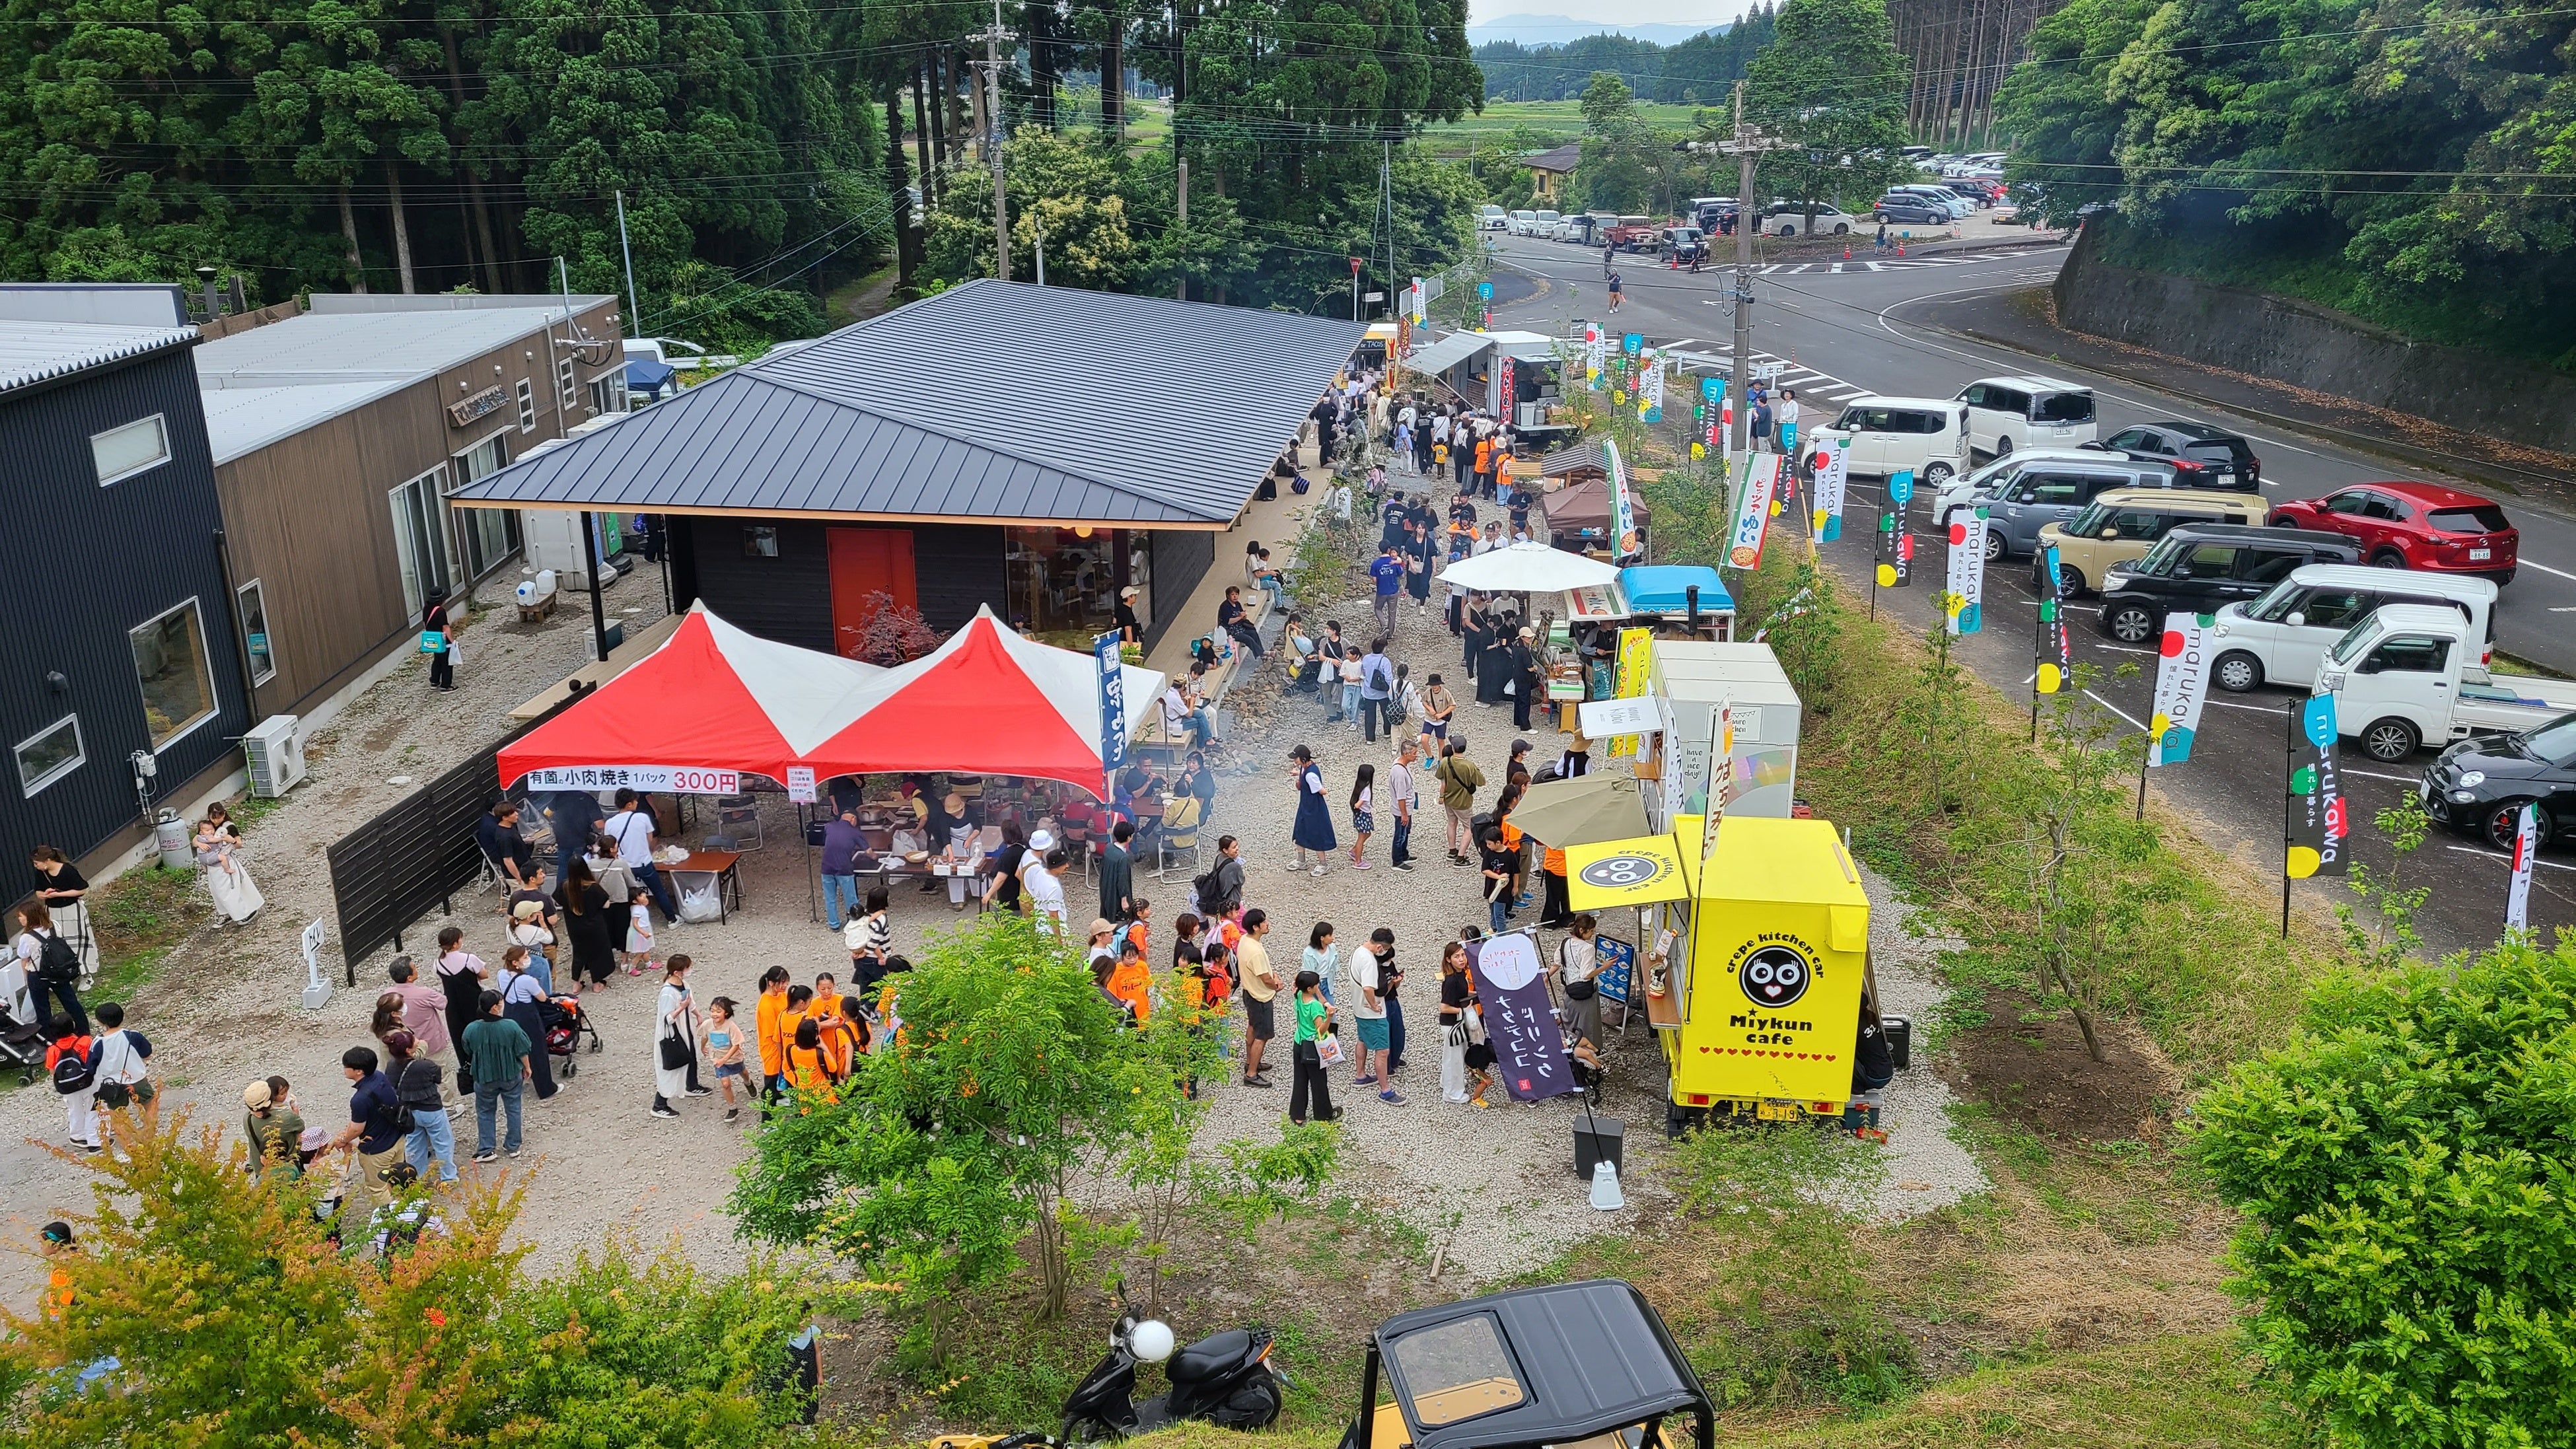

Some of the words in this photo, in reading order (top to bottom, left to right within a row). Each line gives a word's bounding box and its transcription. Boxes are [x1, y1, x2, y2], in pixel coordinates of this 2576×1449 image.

[1826, 448, 1842, 533] marukawa
[1897, 483, 1908, 579] marukawa
[1963, 520, 1981, 623] marukawa
[2165, 628, 2201, 750] marukawa
[674, 771, 738, 792] 300円
[2316, 715, 2339, 864] marukawa
[1618, 850, 1661, 859] crepe
[1651, 857, 1674, 884] kitchen
[1624, 884, 1650, 892] car
[1727, 940, 1756, 973] crepe
[1758, 931, 1814, 956] kitchen
[1812, 956, 1824, 978] car
[1729, 1011, 1812, 1032] Miykun
[1746, 1033, 1793, 1045] cafe
